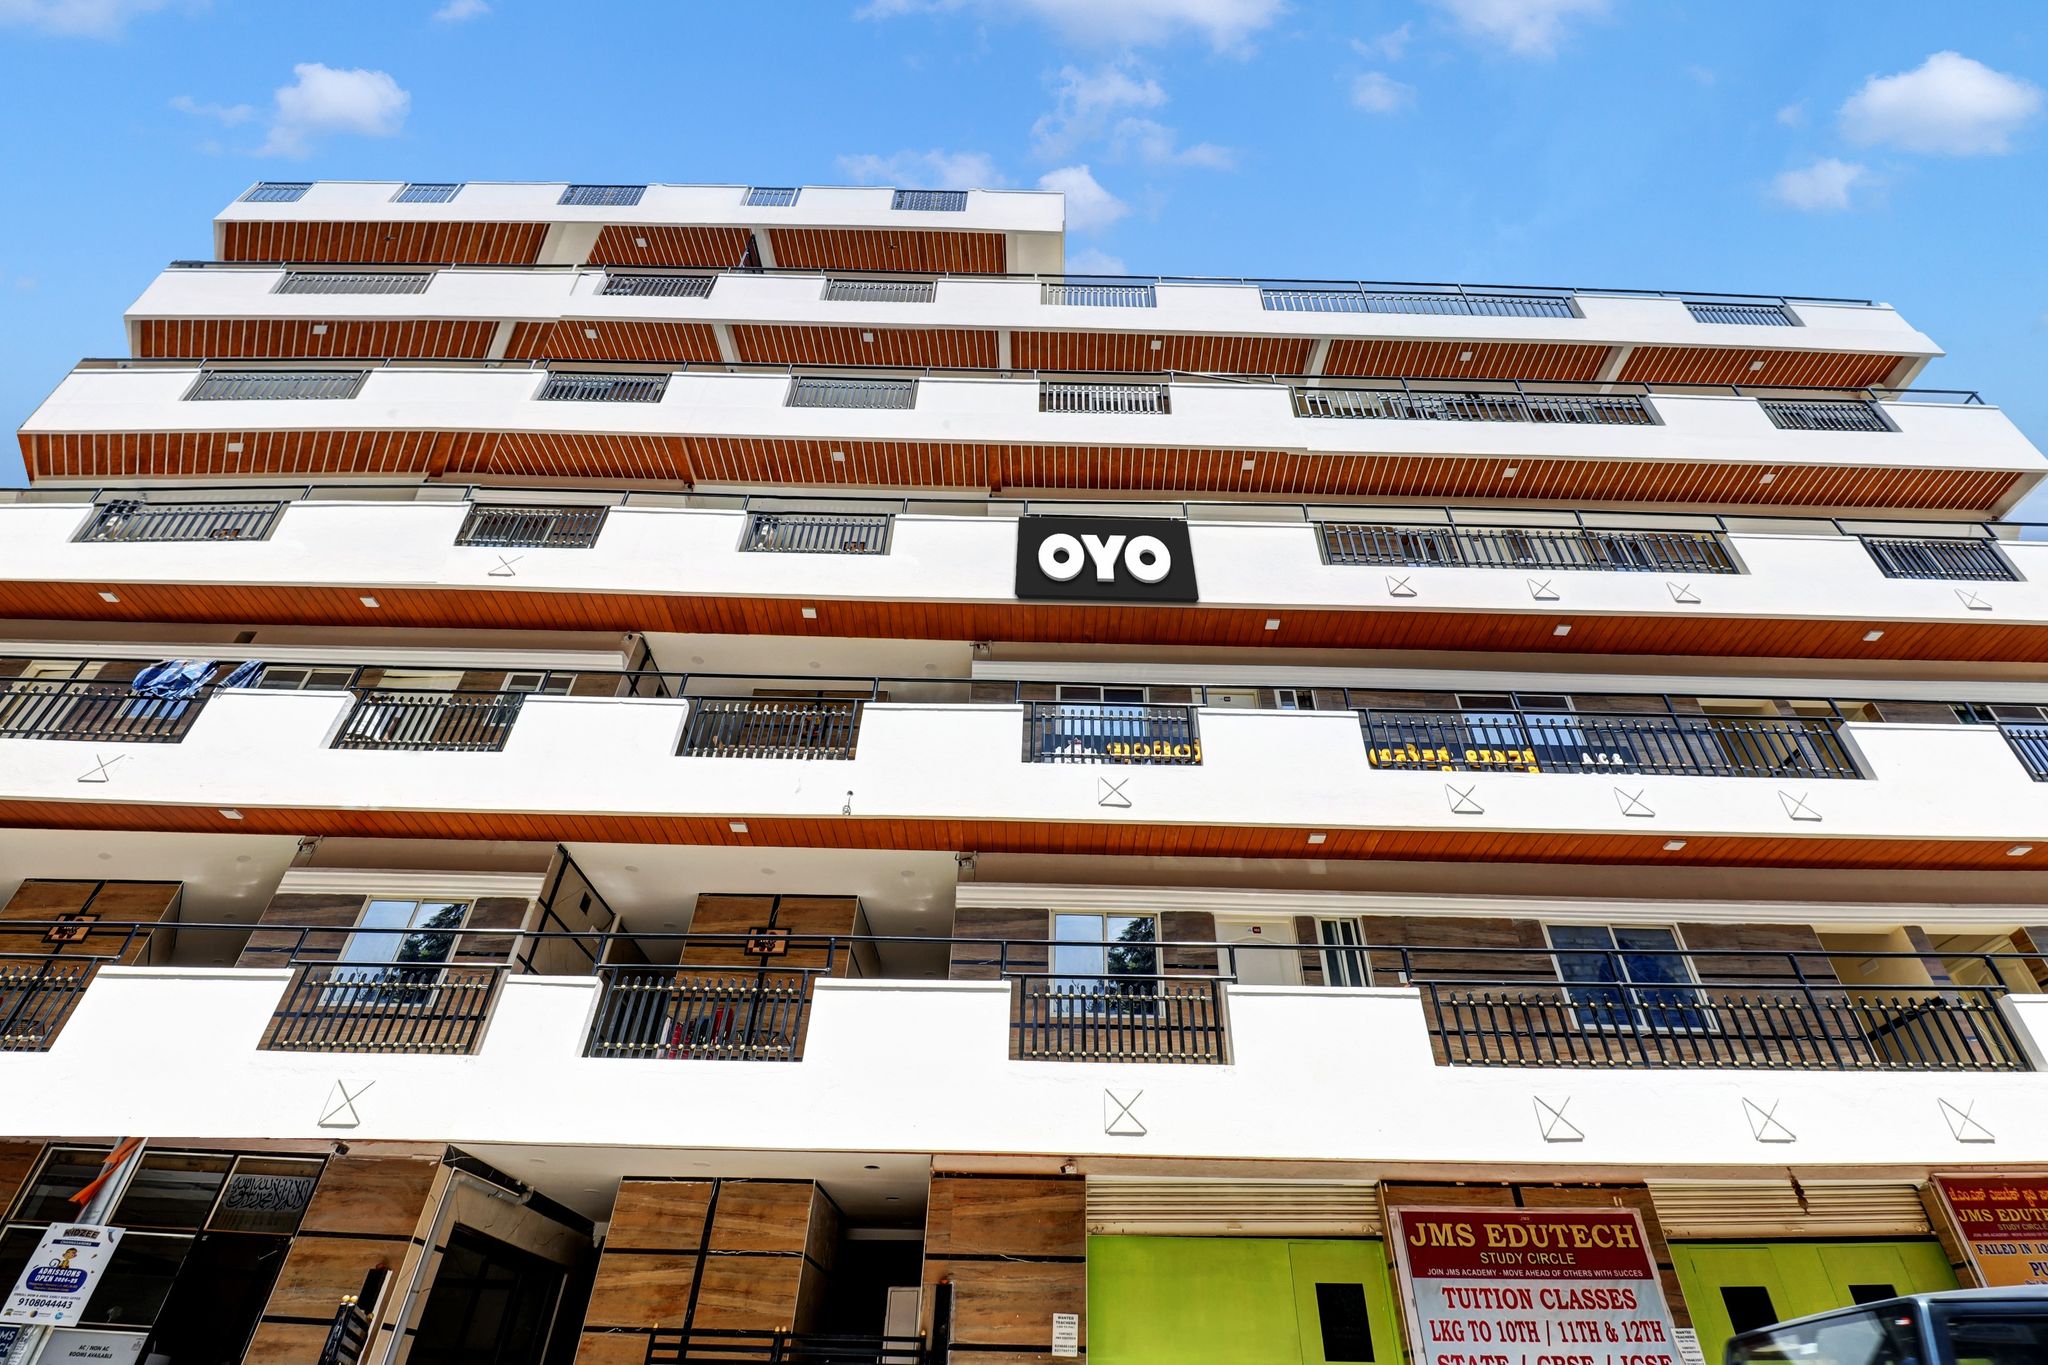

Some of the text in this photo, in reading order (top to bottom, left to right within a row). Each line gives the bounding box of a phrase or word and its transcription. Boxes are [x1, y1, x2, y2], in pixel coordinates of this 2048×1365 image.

[1038, 533, 1171, 583] OYO
[1959, 1209, 1994, 1222] JMS
[63, 1228, 100, 1239] KIDZEE
[1410, 1223, 1640, 1248] JMS EDUTECH
[1976, 1244, 2017, 1254] FAILED
[2018, 1244, 2032, 1254] IN
[1480, 1252, 1576, 1265] STUDY CIRCLE
[38, 1268, 82, 1277] ADMISSIONS
[17, 1298, 73, 1309] 9108044443
[1442, 1287, 1638, 1310] TUITION CLASSES
[1429, 1320, 1465, 1342] LKG
[1468, 1320, 1491, 1342] TO
[1497, 1320, 1540, 1343] 10TH
[1557, 1321, 1602, 1343] 11TH
[1605, 1321, 1619, 1343] &
[1621, 1321, 1666, 1343] 12TH
